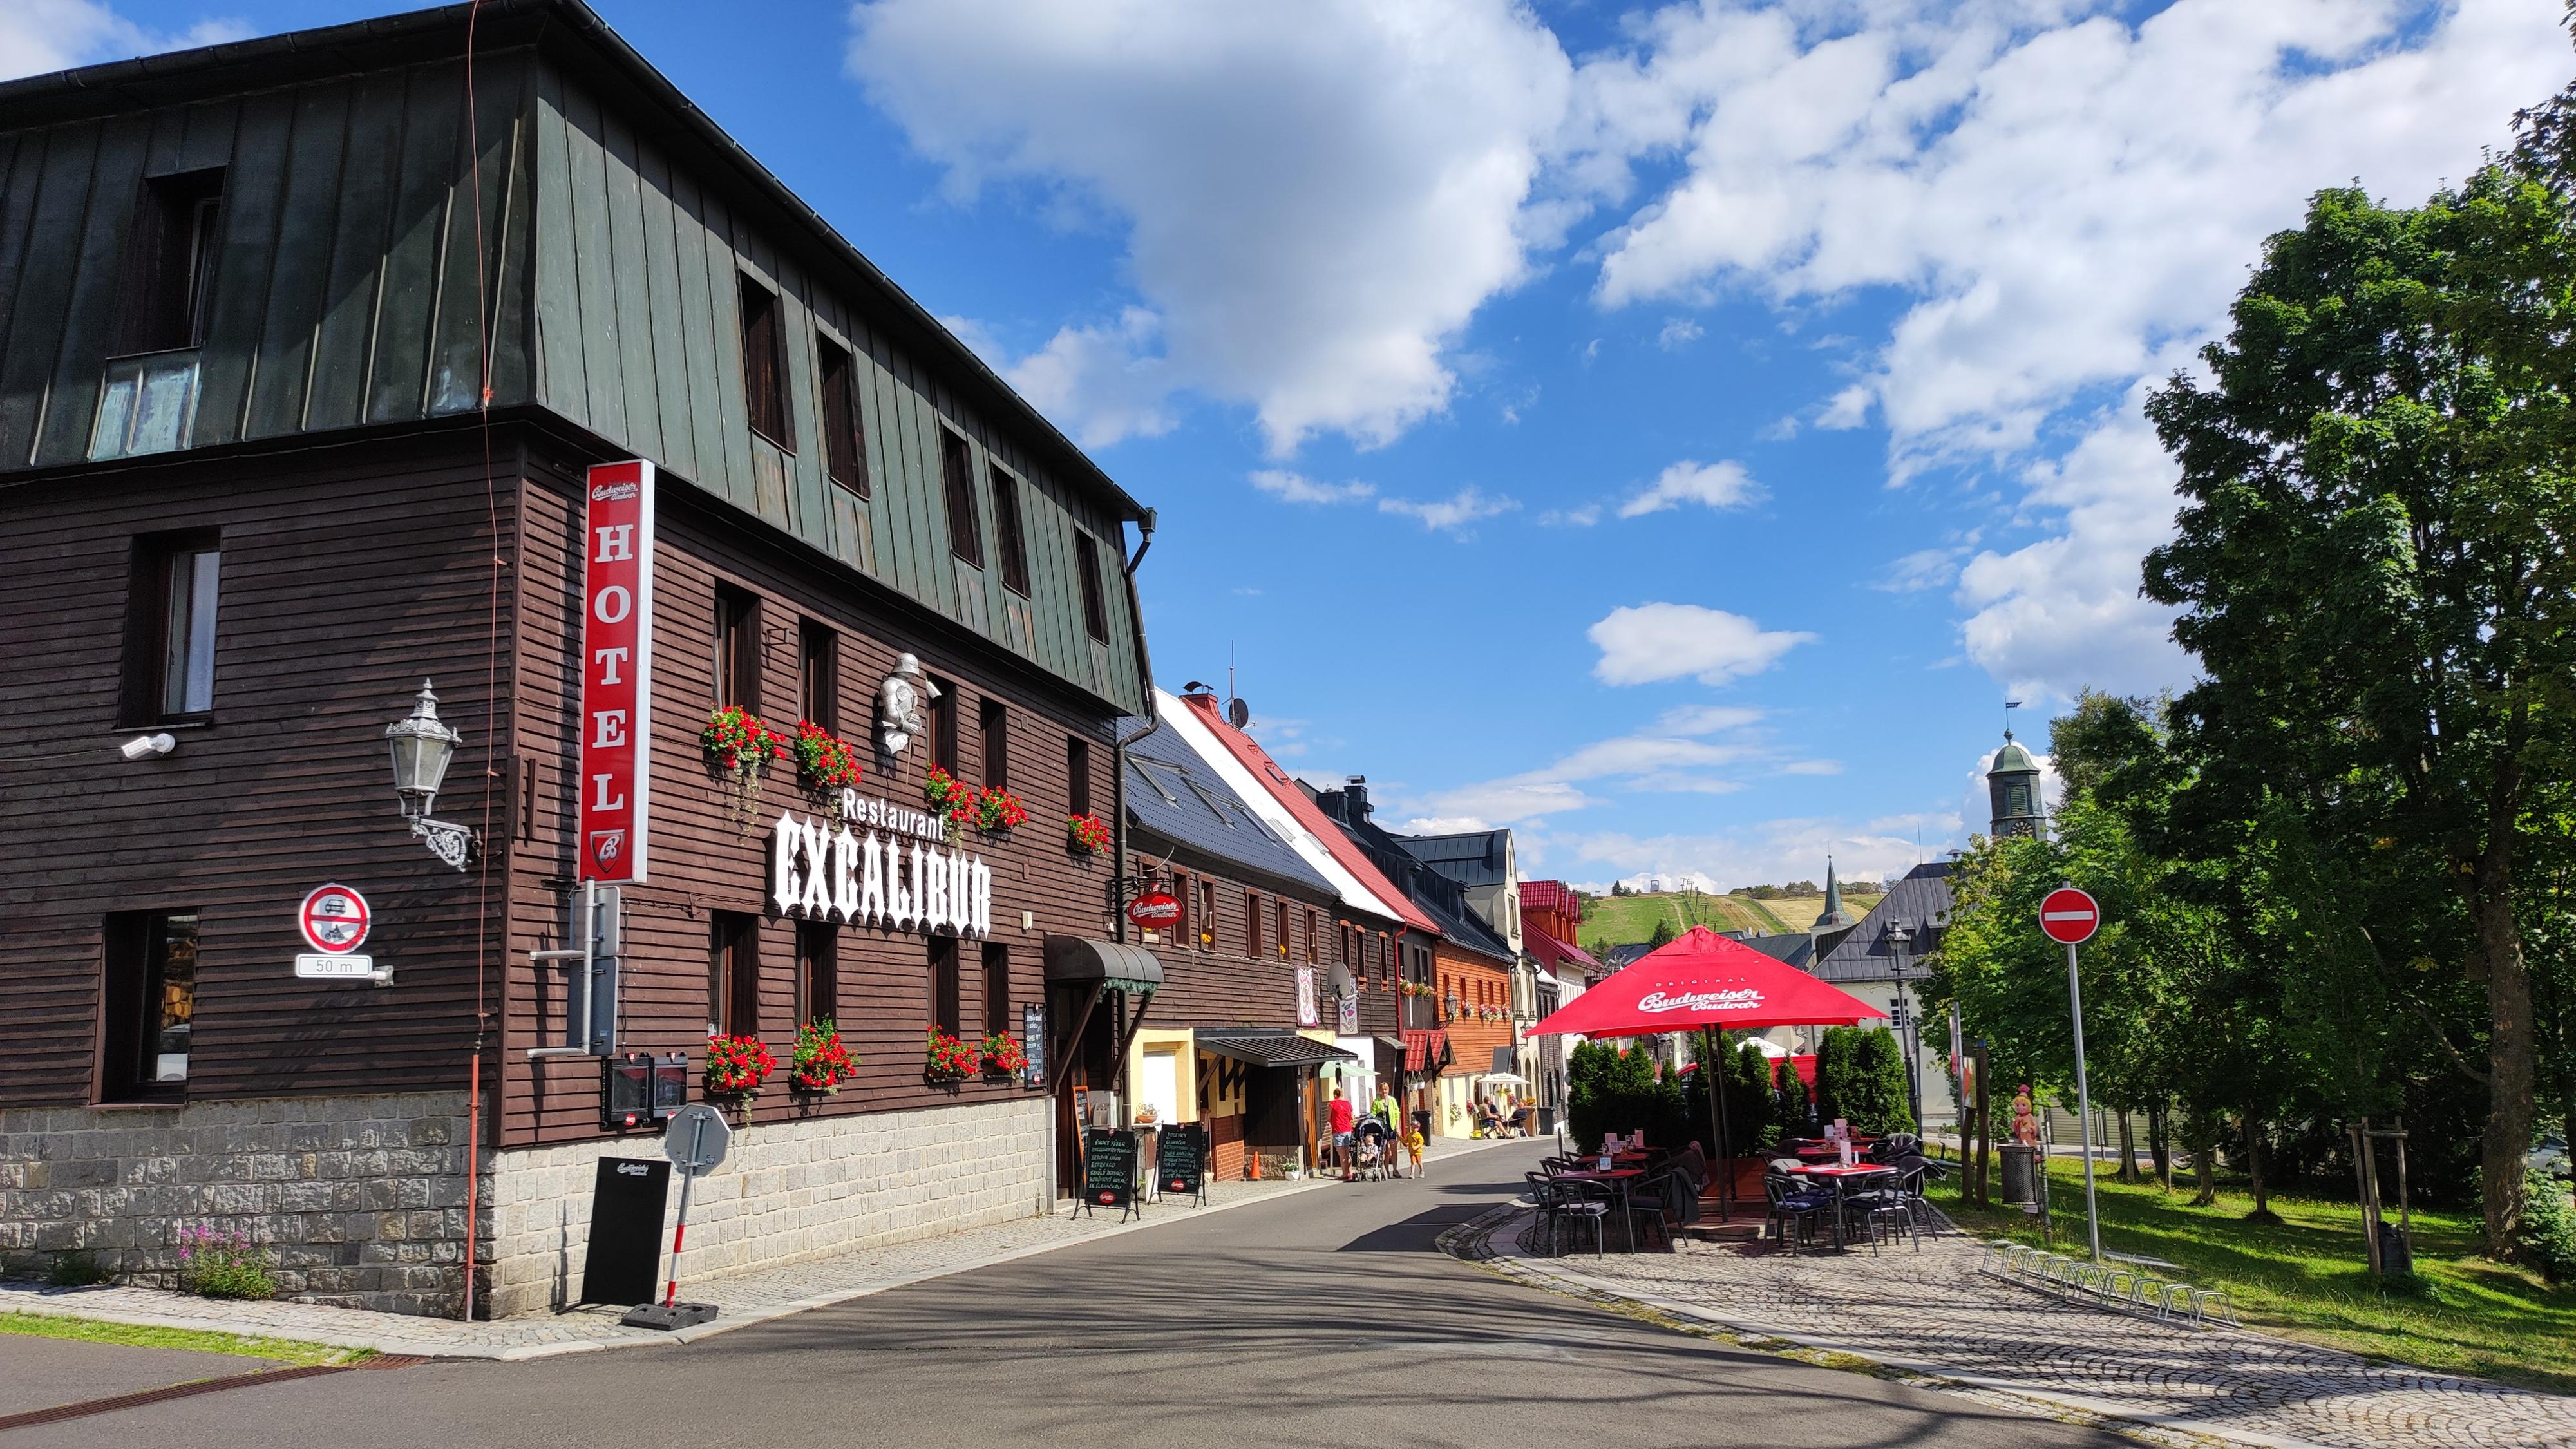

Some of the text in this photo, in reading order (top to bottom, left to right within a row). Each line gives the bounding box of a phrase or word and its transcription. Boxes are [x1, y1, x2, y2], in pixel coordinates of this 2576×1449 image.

[592, 482, 638, 501] Budweiser
[592, 523, 633, 811] HOTEL
[843, 788, 943, 840] Restaurant
[773, 809, 992, 939] EXCALIBUR
[1133, 902, 1179, 917] Budweiser
[316, 960, 352, 972] 50 m
[1655, 977, 1746, 987] ORIGINAL
[1638, 989, 1765, 1012] Budweiser
[1690, 1001, 1762, 1011] Budvar
